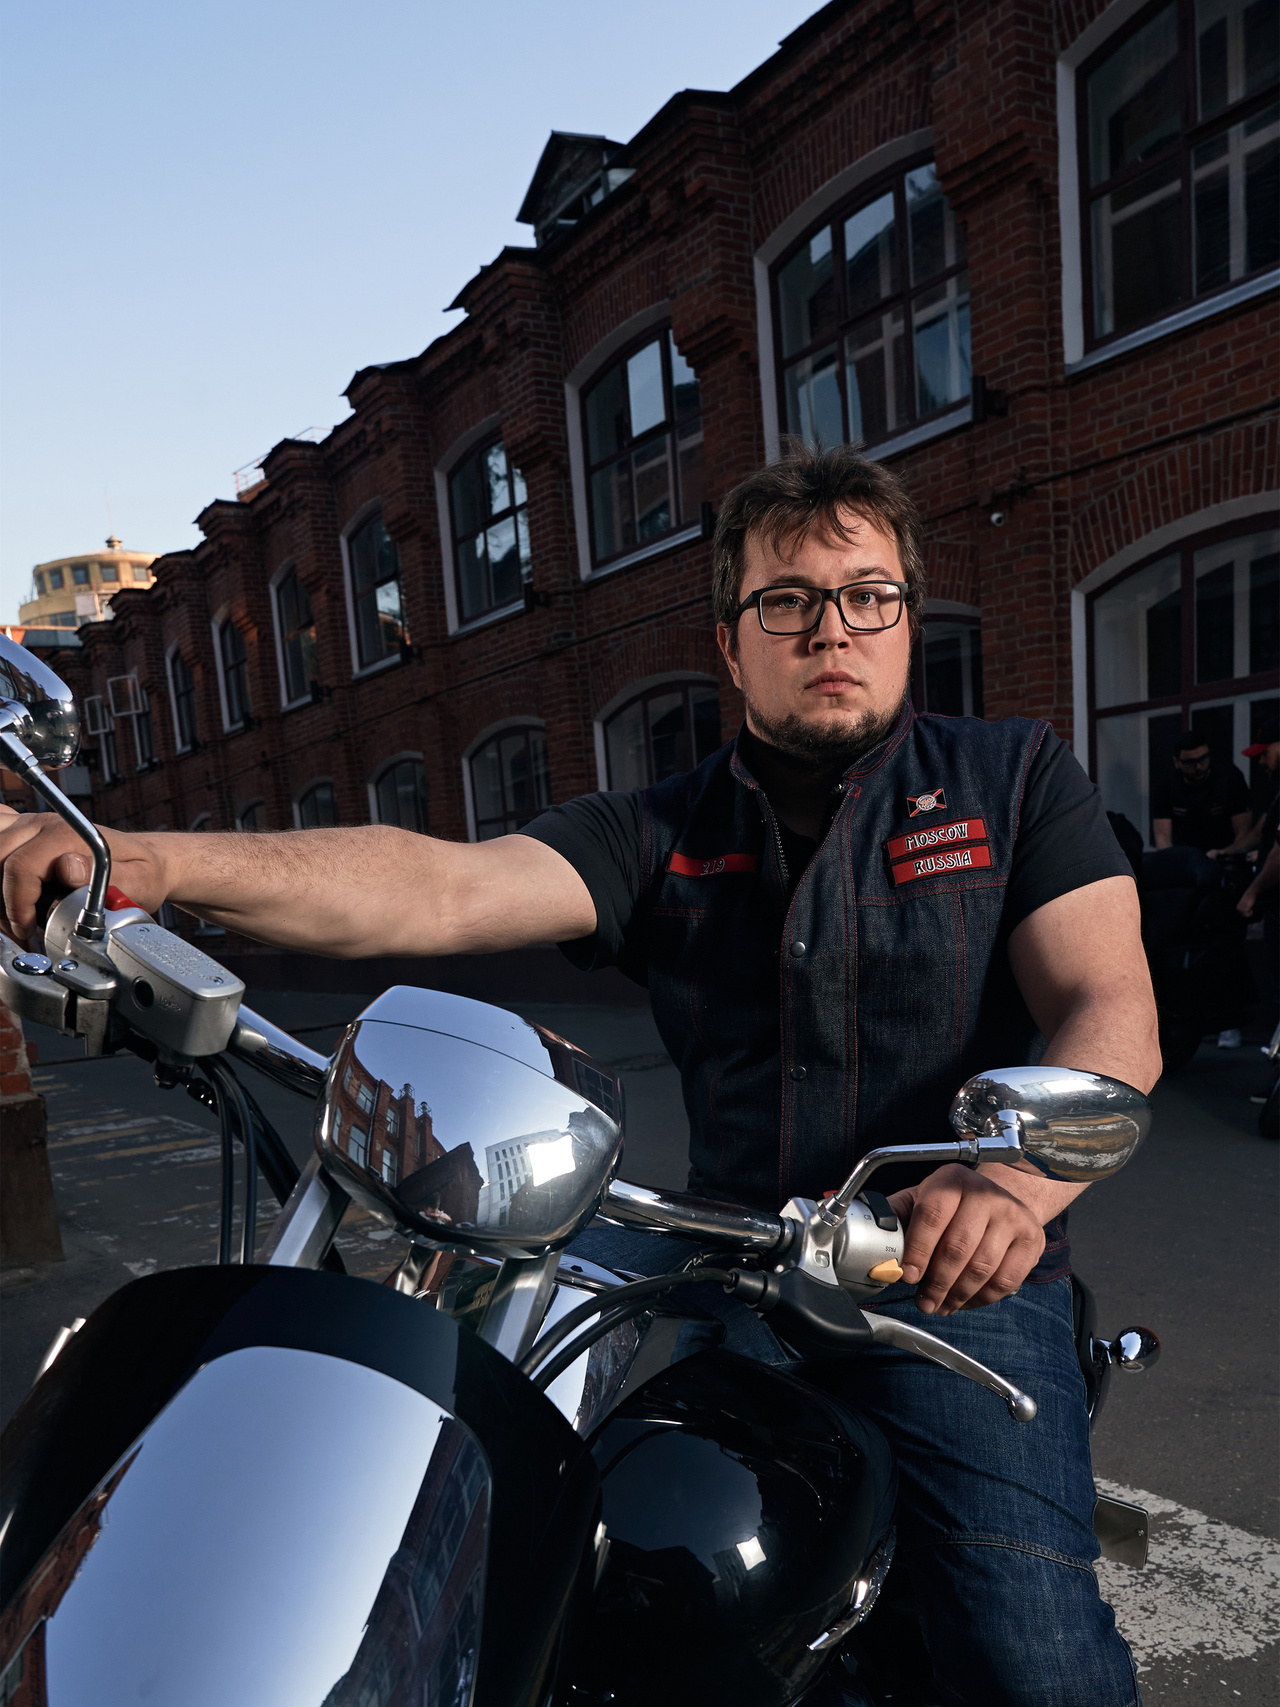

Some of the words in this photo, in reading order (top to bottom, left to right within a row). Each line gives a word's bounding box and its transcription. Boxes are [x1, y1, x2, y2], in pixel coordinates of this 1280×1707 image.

[905, 822, 969, 851] MOSCOW
[700, 858, 726, 876] 219
[913, 850, 973, 875] RUSSIA
